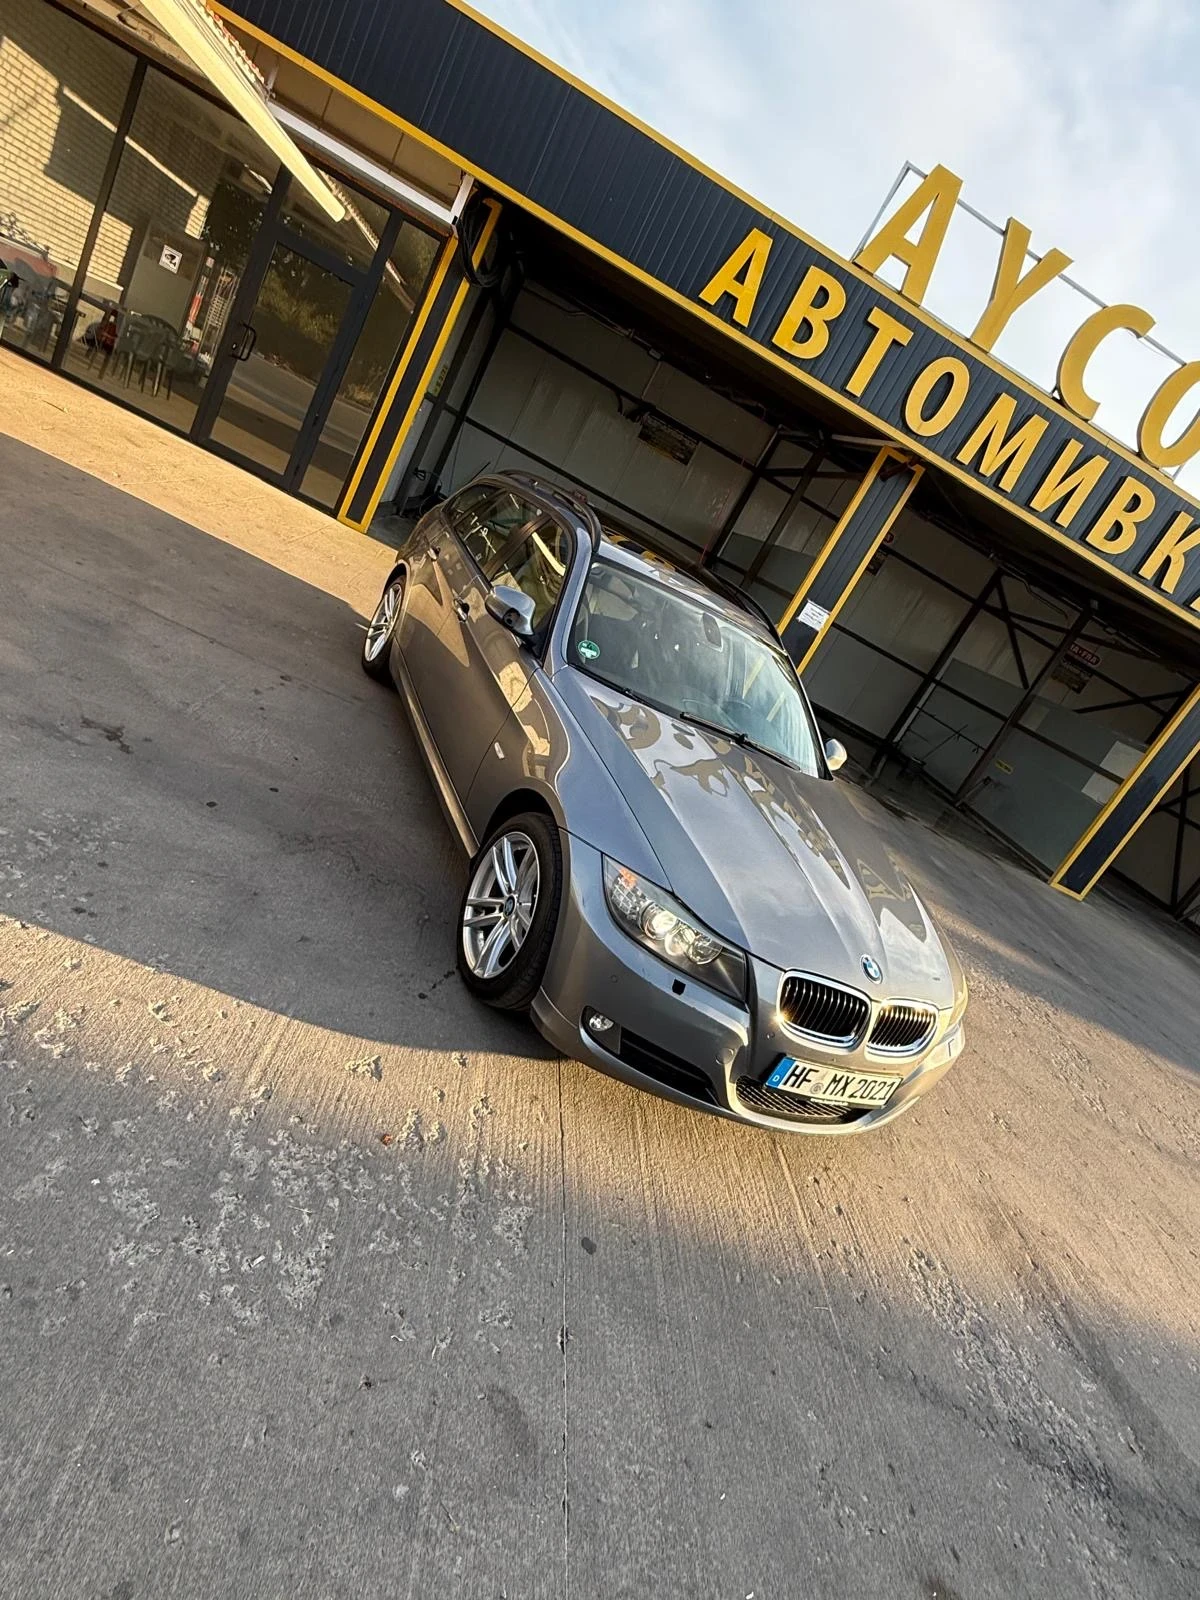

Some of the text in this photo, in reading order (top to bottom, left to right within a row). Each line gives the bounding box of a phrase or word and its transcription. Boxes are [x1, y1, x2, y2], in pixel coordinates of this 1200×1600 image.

[698, 228, 1200, 612] АВТОМИВК
[772, 1065, 896, 1101] D HF MX 2021
